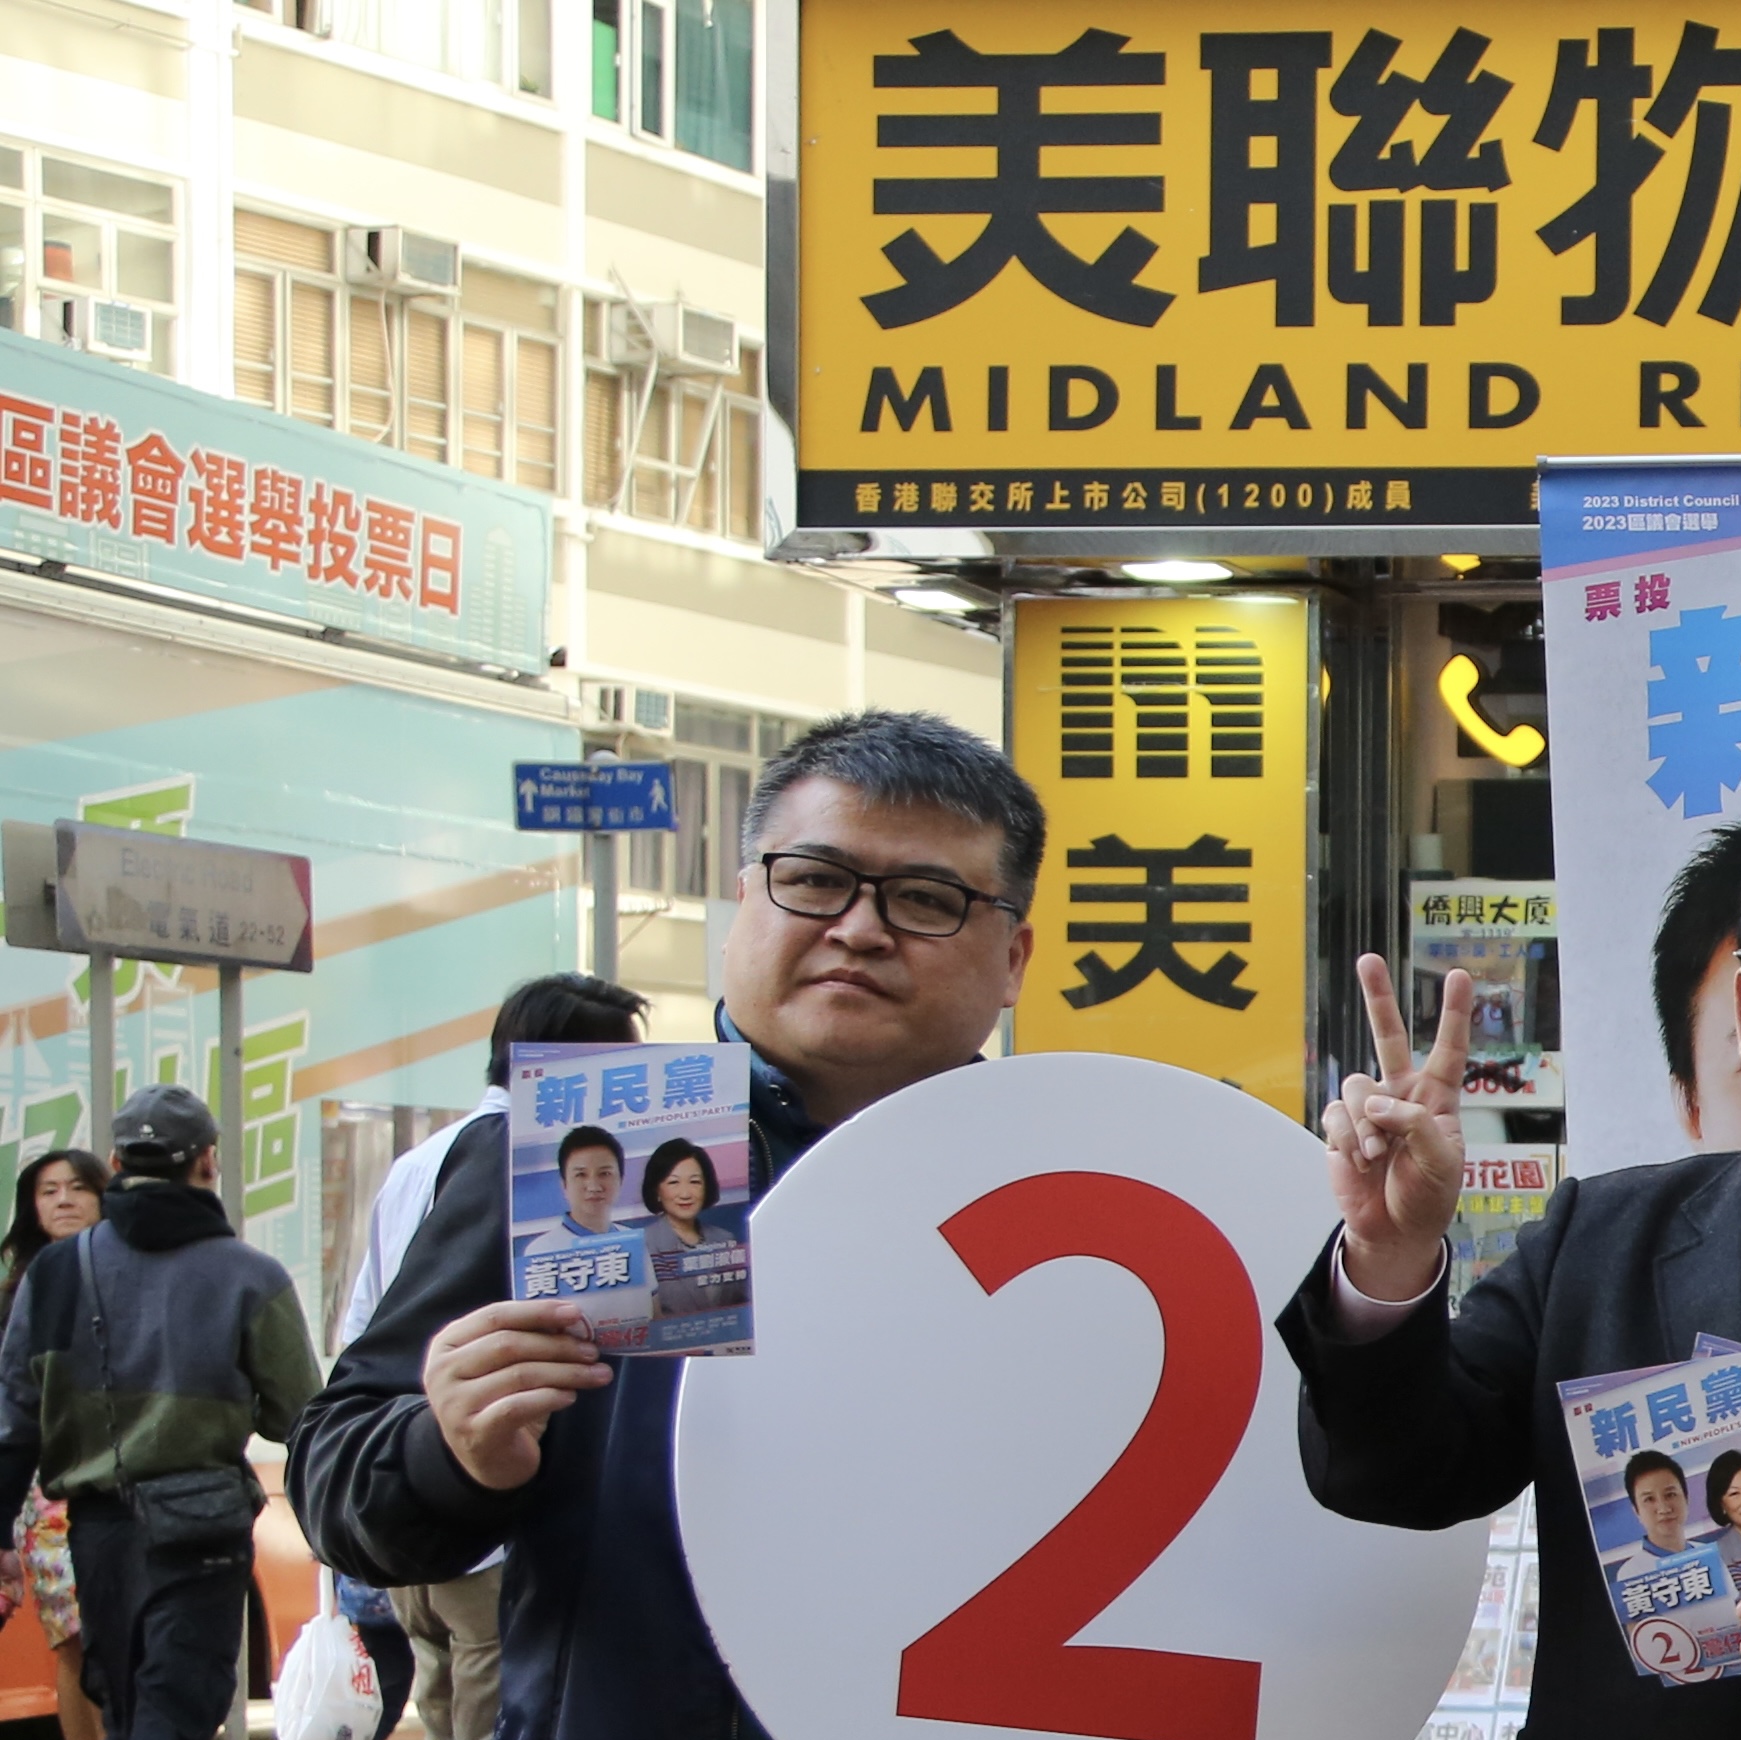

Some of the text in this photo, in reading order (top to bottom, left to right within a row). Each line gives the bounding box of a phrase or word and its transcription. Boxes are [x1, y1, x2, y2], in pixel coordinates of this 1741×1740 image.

[859, 361, 1543, 433] MIDLAND
[0, 400, 464, 616] 區議會選舉投票日
[854, 479, 1414, 515] 香港聯交所上市公司(1200)成員
[1583, 496, 1621, 509] 2023
[1623, 495, 1680, 508] District
[1683, 493, 1740, 508] Council
[1584, 572, 1671, 623] 票投
[617, 767, 645, 785] Bay
[1059, 833, 1259, 1011] 美
[535, 1053, 715, 1128] 新民黨
[702, 1105, 734, 1117] PARTY
[525, 1251, 630, 1298] 黃守東
[1621, 1565, 1714, 1619] 黃守東
[1652, 1631, 1681, 1665] 2
